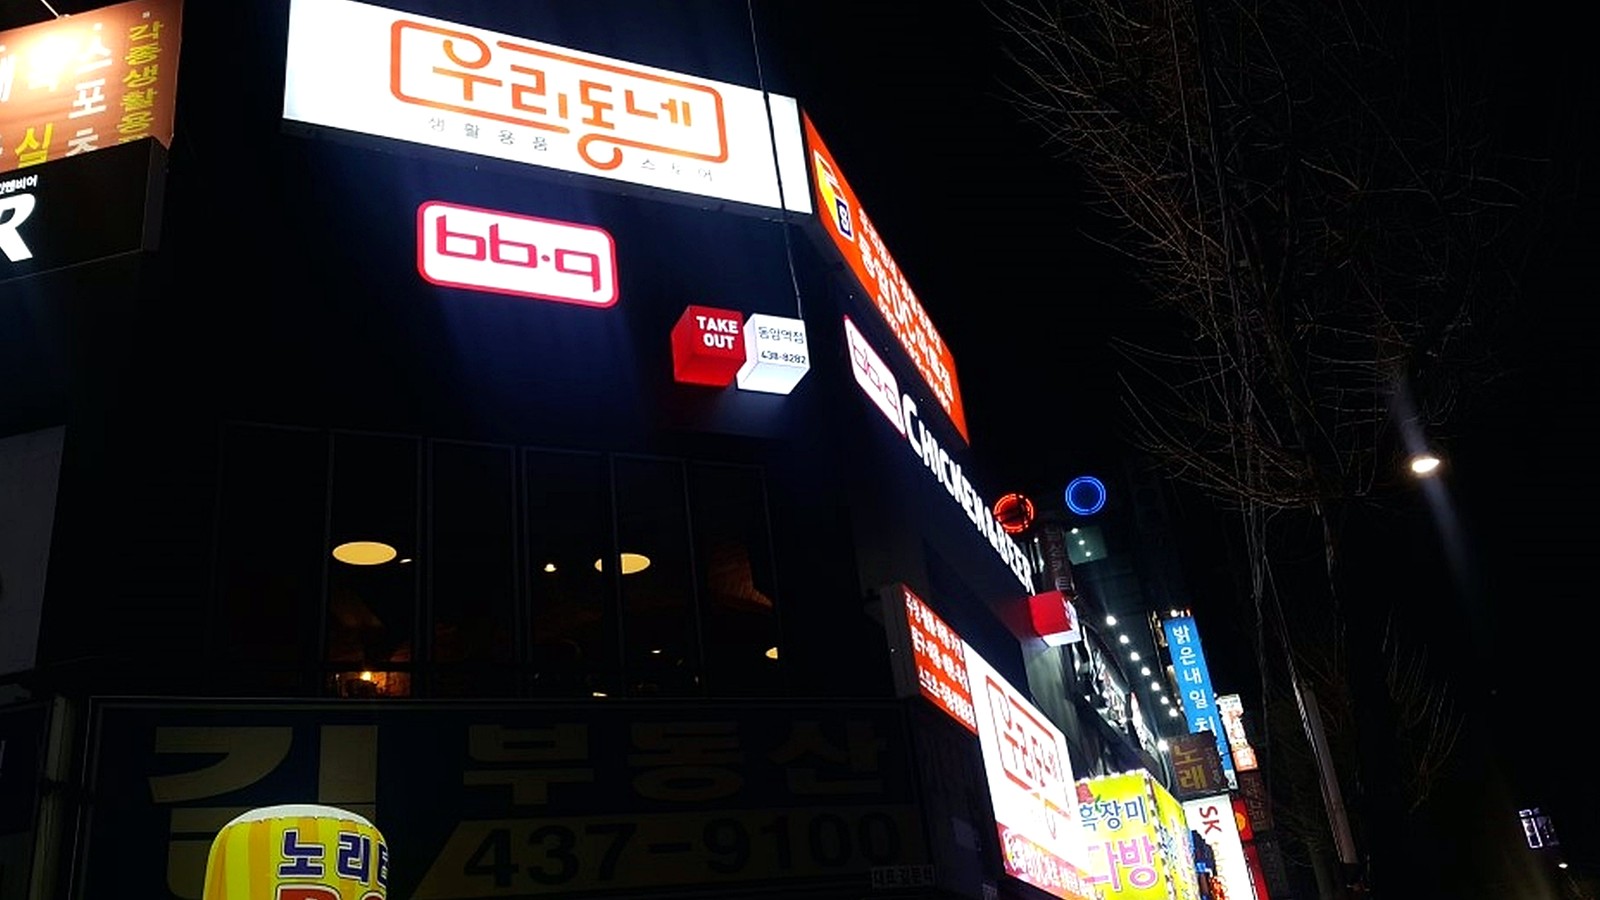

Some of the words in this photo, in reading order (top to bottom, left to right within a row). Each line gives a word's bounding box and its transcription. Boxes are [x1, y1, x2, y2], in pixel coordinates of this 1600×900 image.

[431, 32, 693, 170] 우리동네
[695, 315, 740, 334] TAKE
[757, 325, 805, 345] 동암역점
[703, 334, 735, 350] OUT
[760, 350, 807, 365] 438-8282
[462, 720, 888, 805] 부동산
[1079, 795, 1148, 832] 흑장미
[1199, 805, 1223, 835] SK
[462, 810, 904, 888] 437-9100
[1084, 835, 1159, 891] 다방
